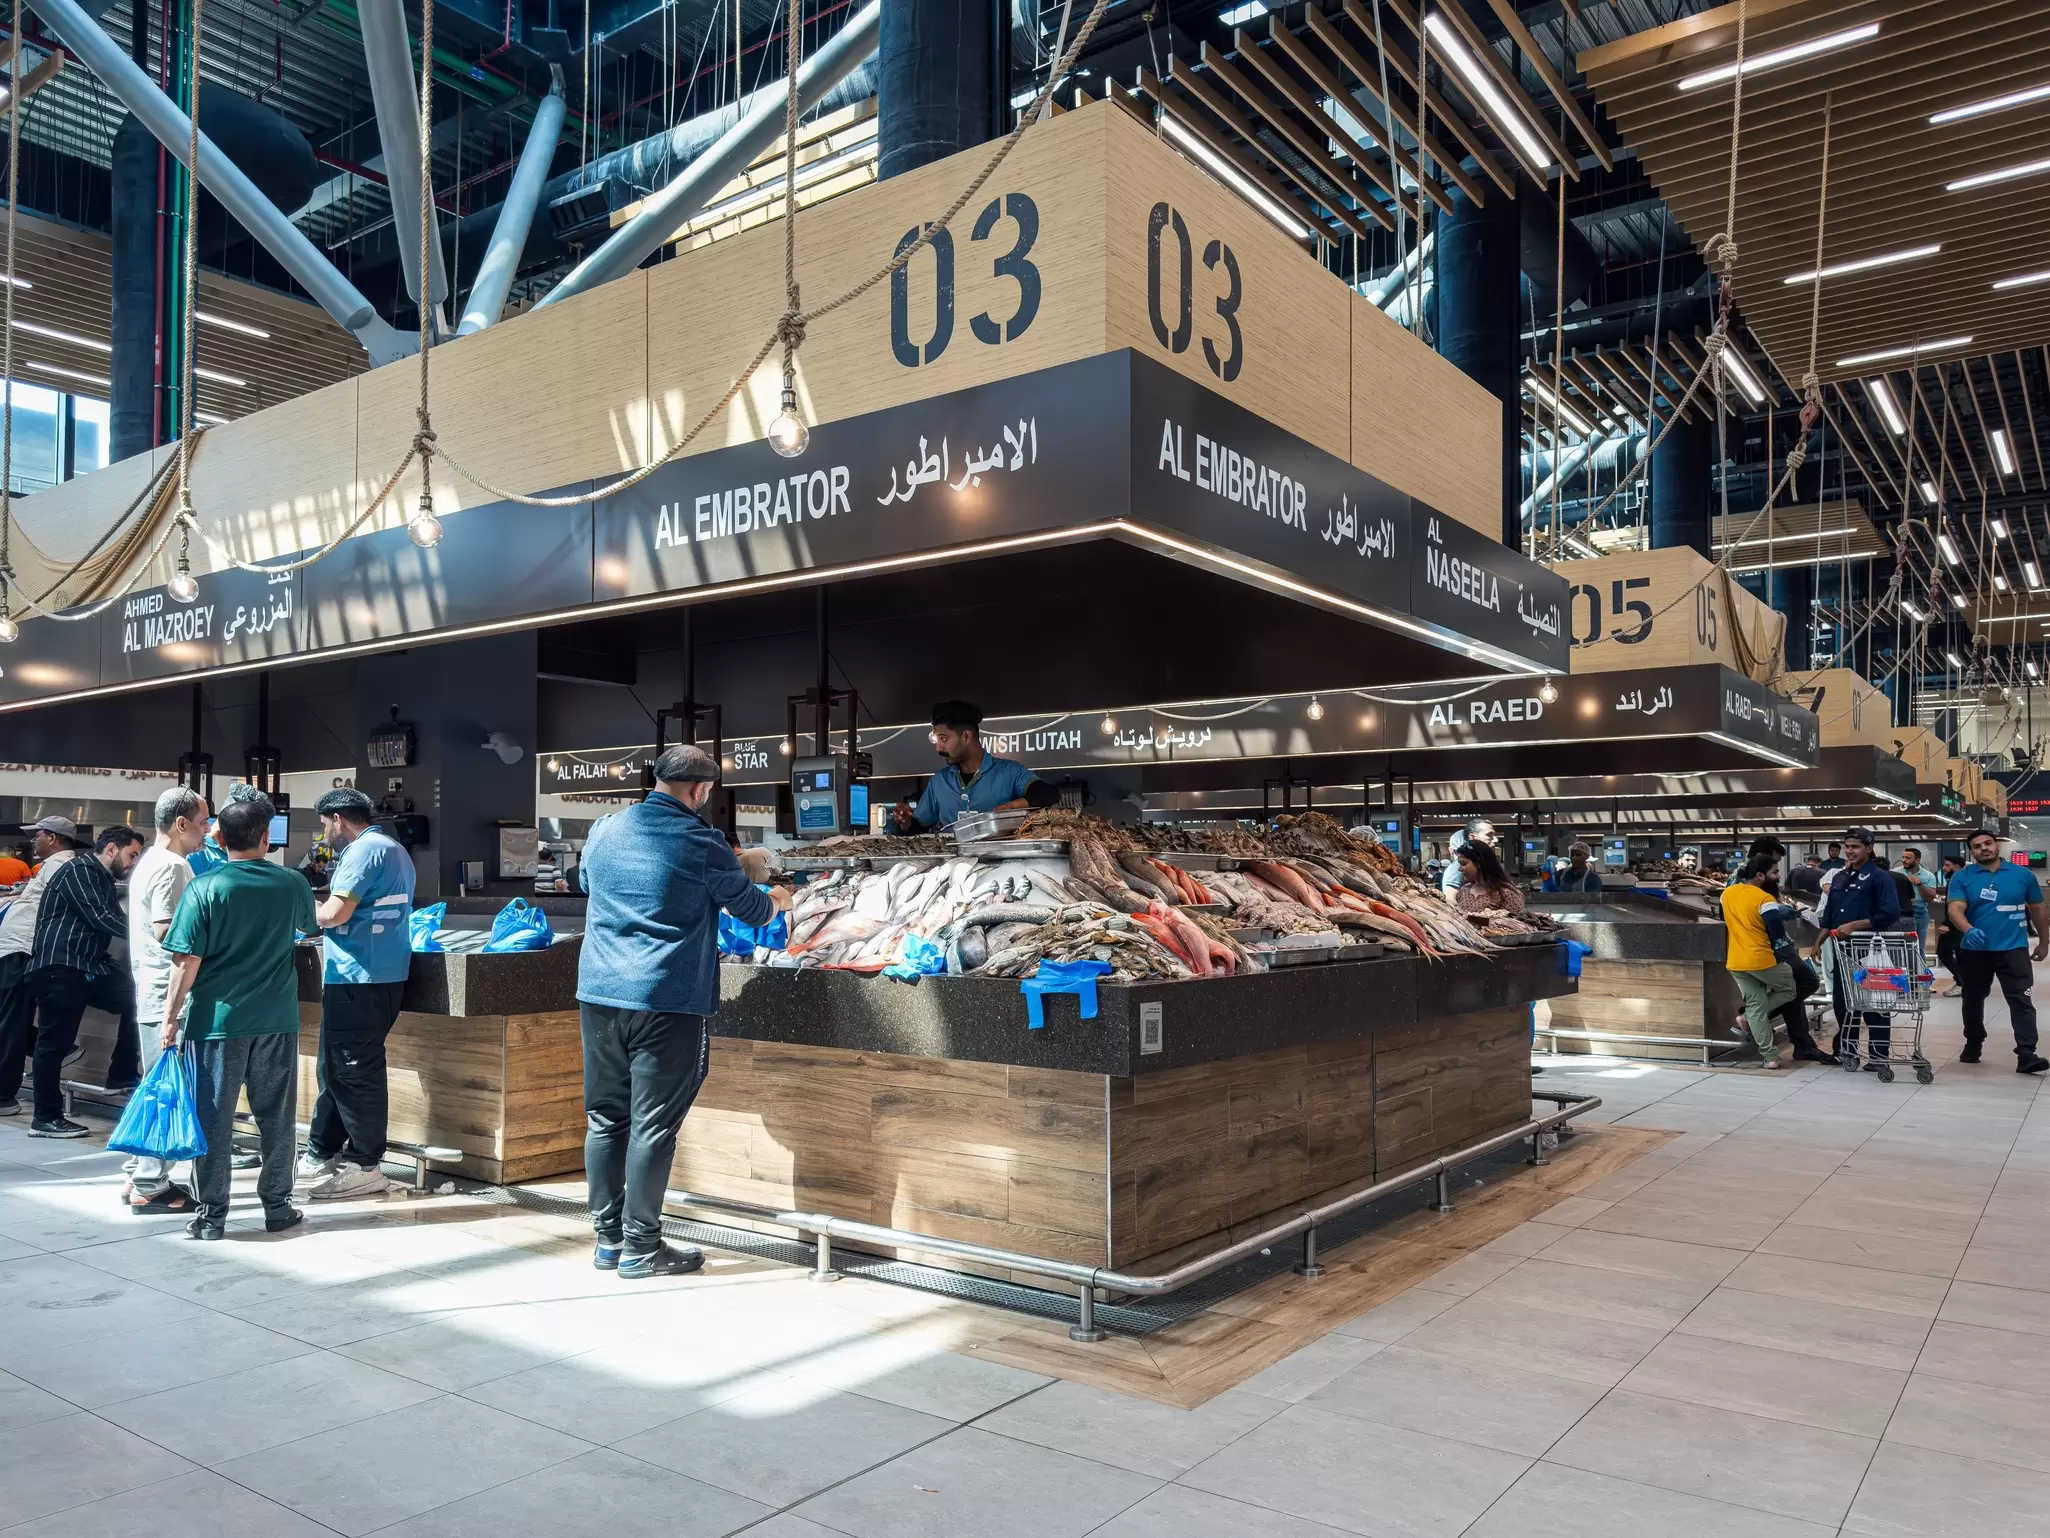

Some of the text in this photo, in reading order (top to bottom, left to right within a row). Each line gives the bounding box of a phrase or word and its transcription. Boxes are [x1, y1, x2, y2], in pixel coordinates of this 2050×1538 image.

[891, 193, 1042, 367] 03
[1148, 202, 1243, 382] 03
[1158, 418, 1307, 532] AL EMBRATOR
[655, 465, 851, 550] AL EMBRATOR
[1427, 517, 1442, 545] AL
[1426, 550, 1500, 613] NASEELA
[124, 594, 163, 619] AHMED
[223, 587, 292, 646] المزروعي
[1569, 577, 1653, 648] 05
[1697, 582, 1717, 652] 05
[123, 605, 214, 653] AL MAZROEY
[1428, 697, 1544, 727] AL RAED
[1616, 686, 1672, 715] الرائد
[1725, 688, 1734, 714] AL
[1735, 693, 1752, 720] RAED
[1797, 686, 1826, 714] 7
[734, 743, 756, 752] BLUE
[979, 730, 1081, 754] WISH LUTAH
[557, 764, 607, 780] AL FALAH
[734, 752, 768, 769] STAR
[333, 777, 356, 788] CA
